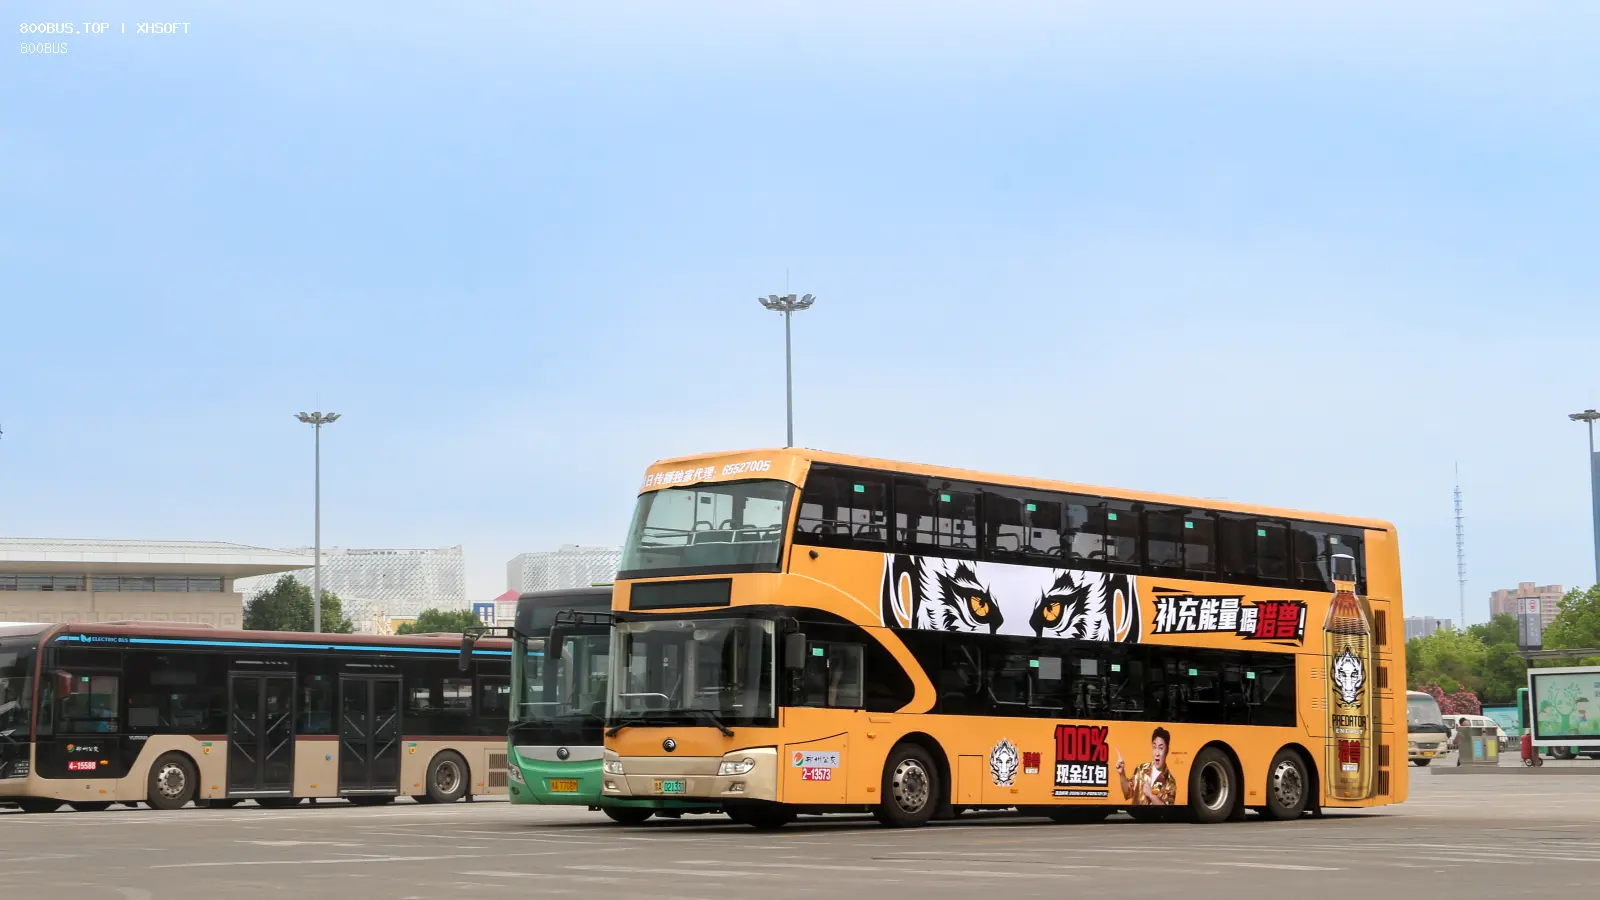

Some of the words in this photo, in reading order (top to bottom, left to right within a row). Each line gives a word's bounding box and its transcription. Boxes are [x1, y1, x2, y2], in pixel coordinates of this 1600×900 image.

[644, 466, 716, 487] 日传播独家代理：
[722, 460, 771, 476] 65527005
[1332, 714, 1366, 732] PREDATOR
[1054, 725, 1109, 763] 100%
[68, 761, 97, 770] 4-15588
[802, 767, 831, 780] 2-13573
[1056, 764, 1107, 784] 现金红包
